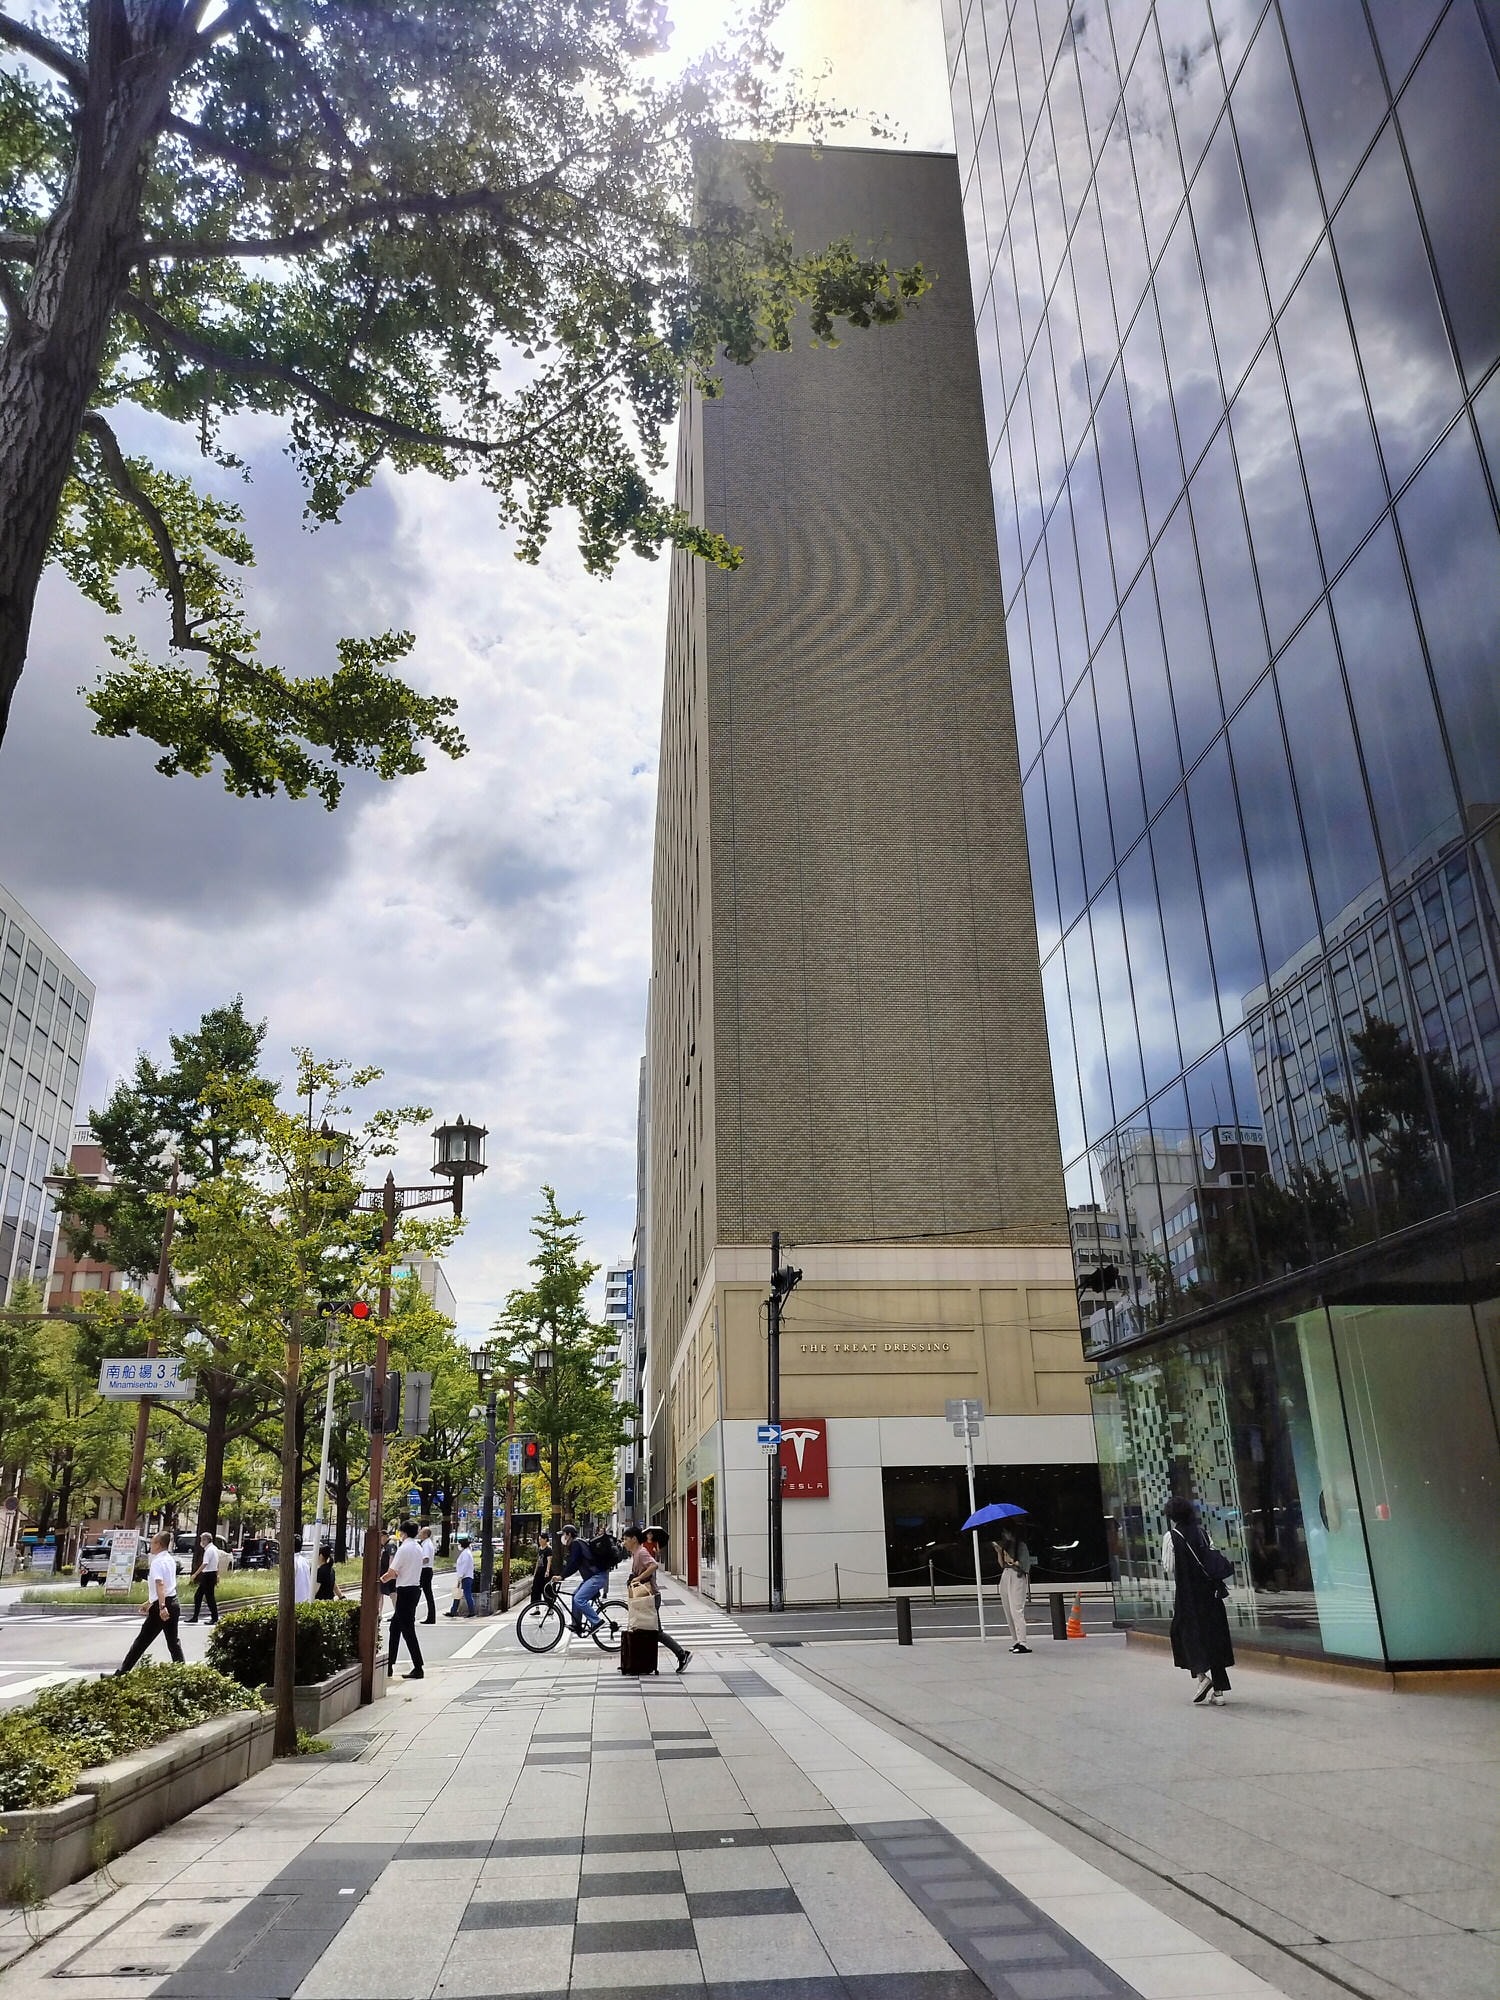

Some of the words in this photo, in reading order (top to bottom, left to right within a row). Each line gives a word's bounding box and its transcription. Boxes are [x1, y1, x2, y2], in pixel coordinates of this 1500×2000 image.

[801, 1343, 827, 1352] THE
[834, 1343, 877, 1352] TREAT
[884, 1342, 950, 1352] DRESSING
[109, 1380, 158, 1389] Minamisenba
